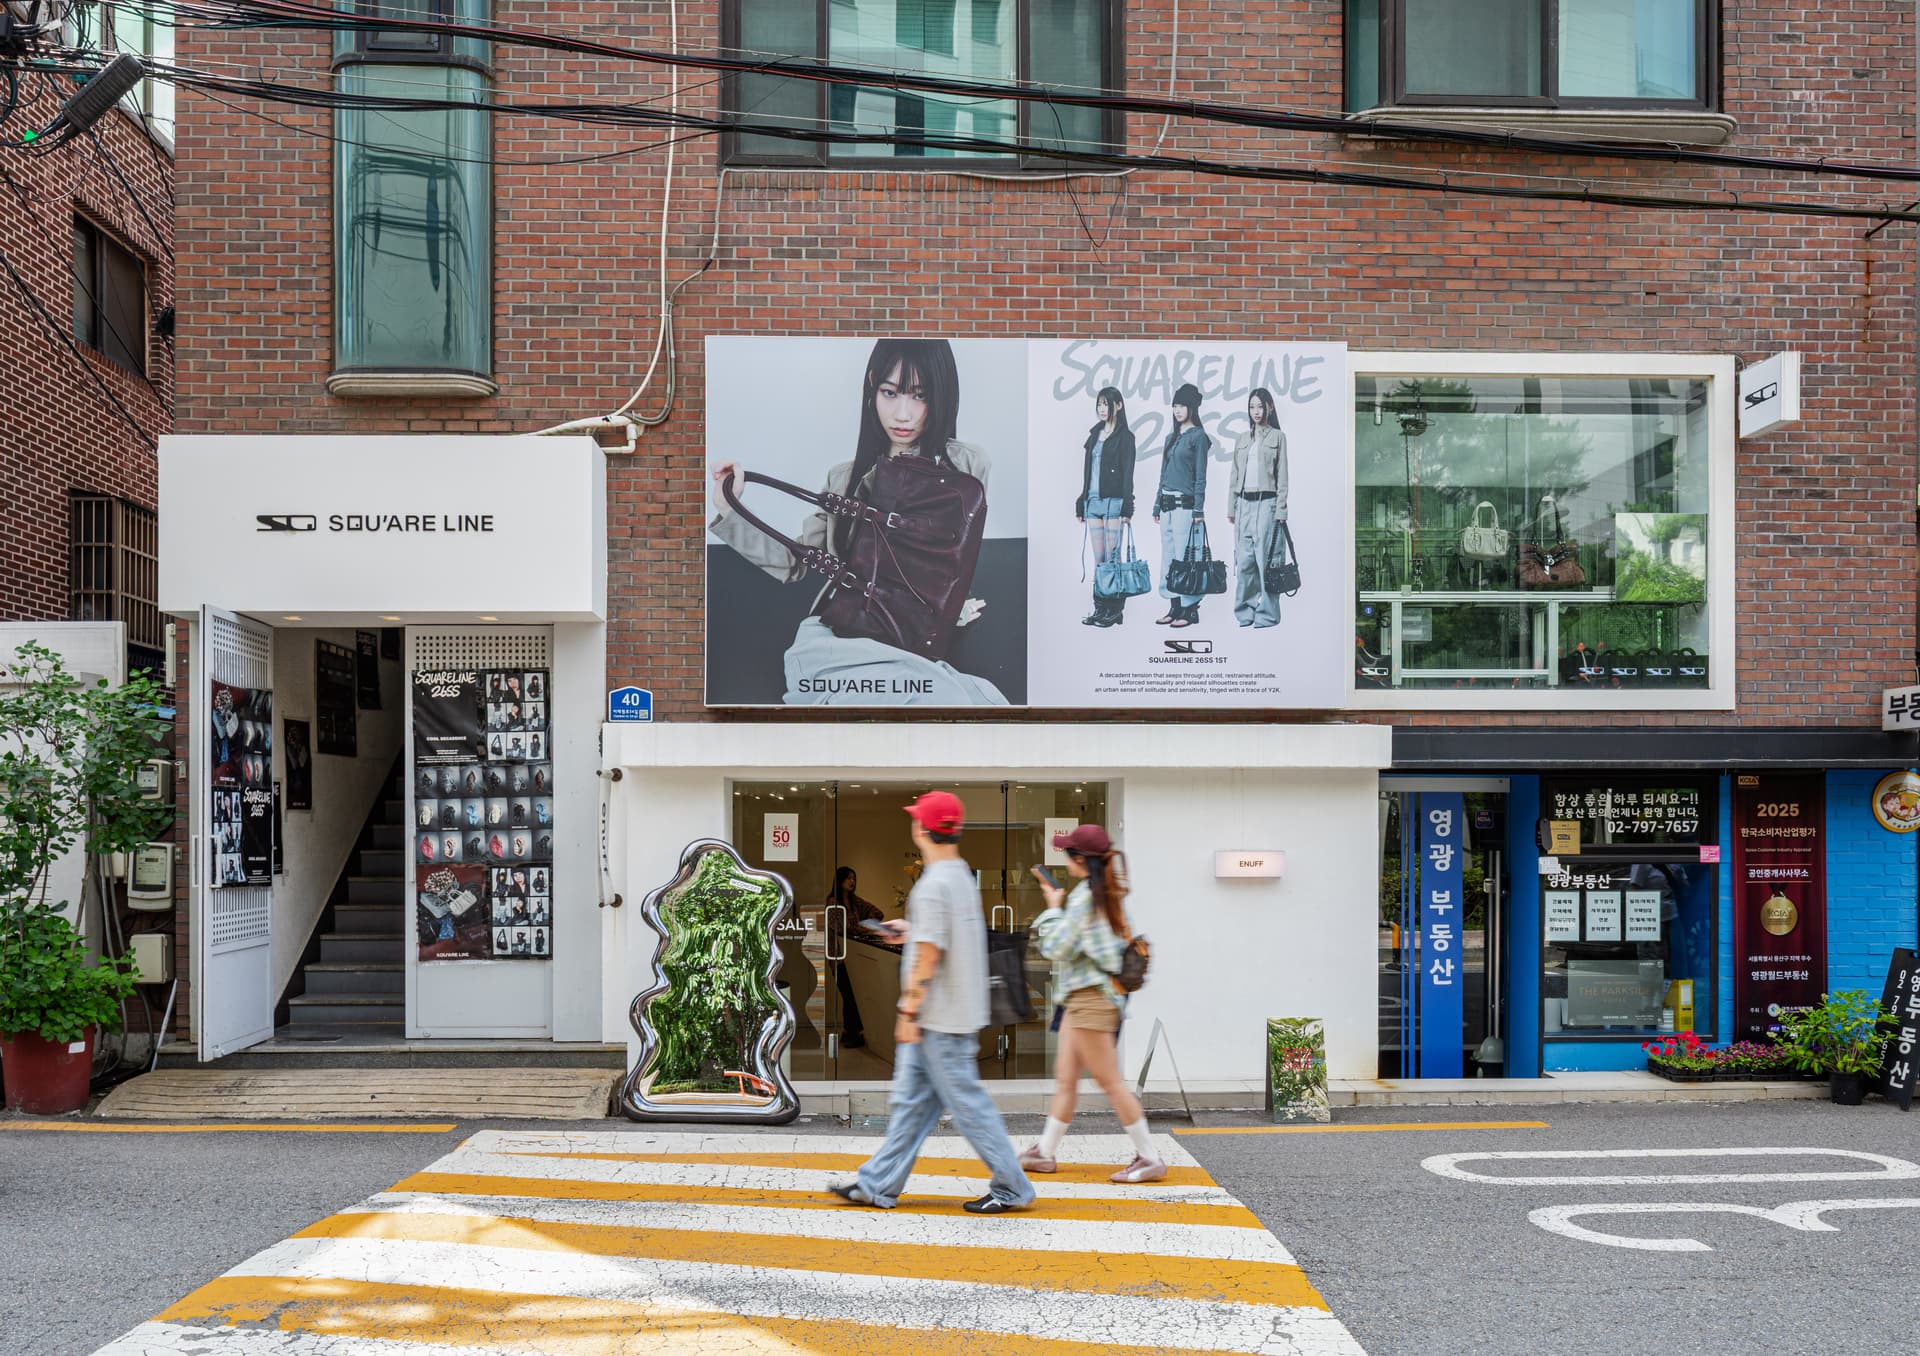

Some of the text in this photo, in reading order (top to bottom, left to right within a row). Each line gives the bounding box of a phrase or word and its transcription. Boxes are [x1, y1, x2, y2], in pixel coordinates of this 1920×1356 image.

[1053, 339, 1325, 405] SQUARELINE
[443, 514, 494, 532] LINE
[415, 669, 477, 685] SQUARELINE
[1183, 672, 1205, 680] through
[1210, 672, 1224, 680] cold,
[430, 685, 461, 698] 26SS
[892, 679, 933, 693] LINE
[621, 693, 640, 706] 40
[1555, 792, 1699, 807] 항상 좋은 하루 되세요~!!
[1555, 807, 1699, 818] 부동산 문의 언제나 환영 합니다.
[1757, 803, 1800, 817] 2025
[1607, 820, 1699, 834] 02-797-7657
[1740, 827, 1816, 838] 한국소비자산업평가
[773, 830, 790, 843] 50
[1239, 860, 1264, 868] ENUFF
[1748, 868, 1809, 878] 공인중개사사무소
[1547, 873, 1611, 890] 영광부동산
[1429, 809, 1455, 986] 영광 부동산
[776, 918, 815, 931] SALE
[1751, 970, 1809, 981] 영광월드부동산
